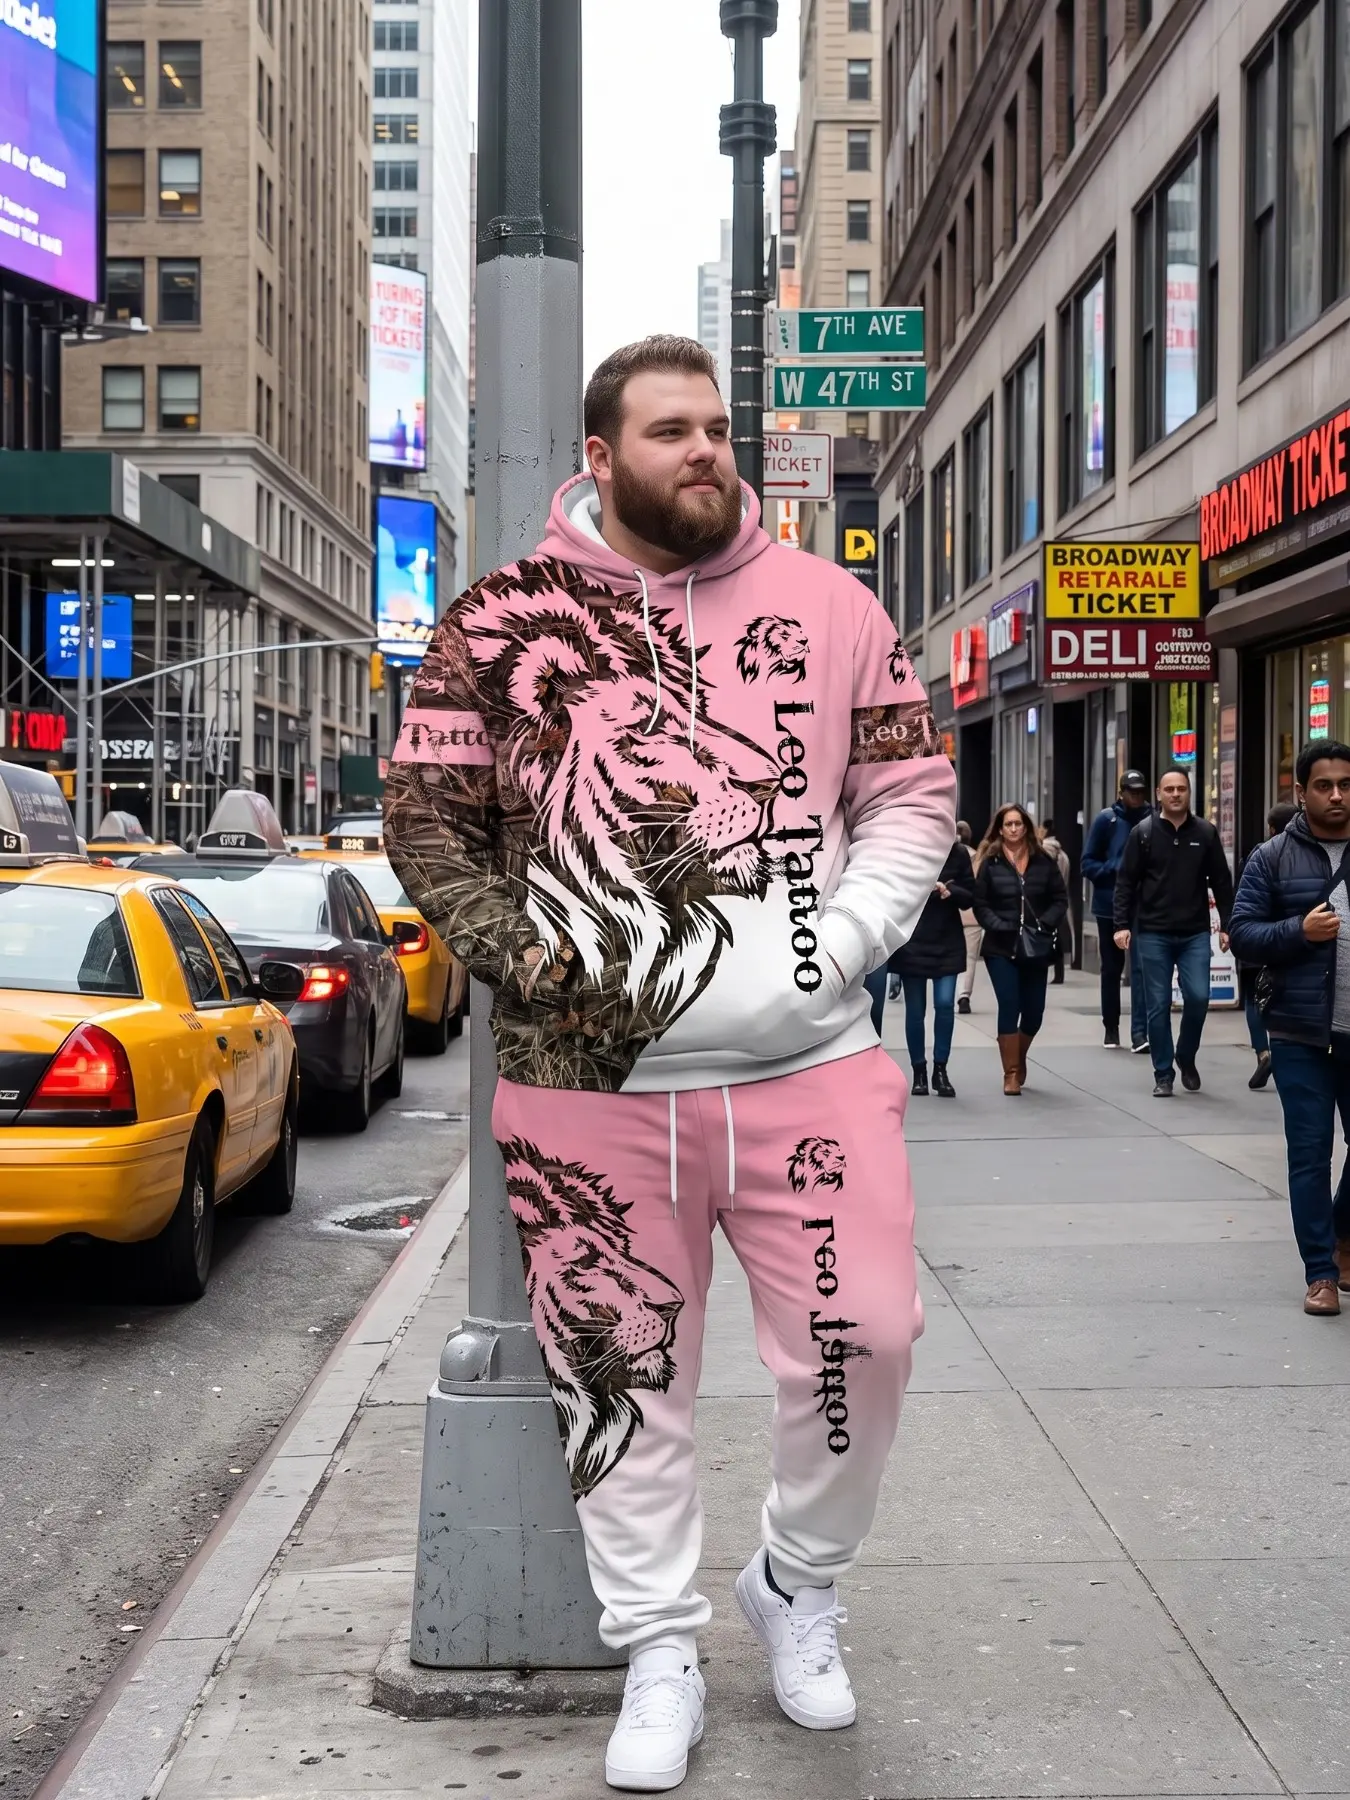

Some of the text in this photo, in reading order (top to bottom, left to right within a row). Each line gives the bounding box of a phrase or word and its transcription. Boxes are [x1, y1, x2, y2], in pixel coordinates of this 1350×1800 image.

[813, 316, 855, 351] 7TH
[868, 315, 907, 336] AVE
[780, 371, 915, 405] W 47TH ST
[763, 457, 822, 472] TICKET
[1201, 449, 1286, 562] BROADWAY
[1289, 408, 1350, 516] TICKE
[1052, 547, 1191, 567] BROADWAY
[1058, 571, 1187, 588] RETARALE
[1067, 593, 1176, 614] TICKET
[1051, 629, 1147, 666] DELI
[857, 719, 908, 745] Leo
[765, 700, 825, 996] Leo Tattoo
